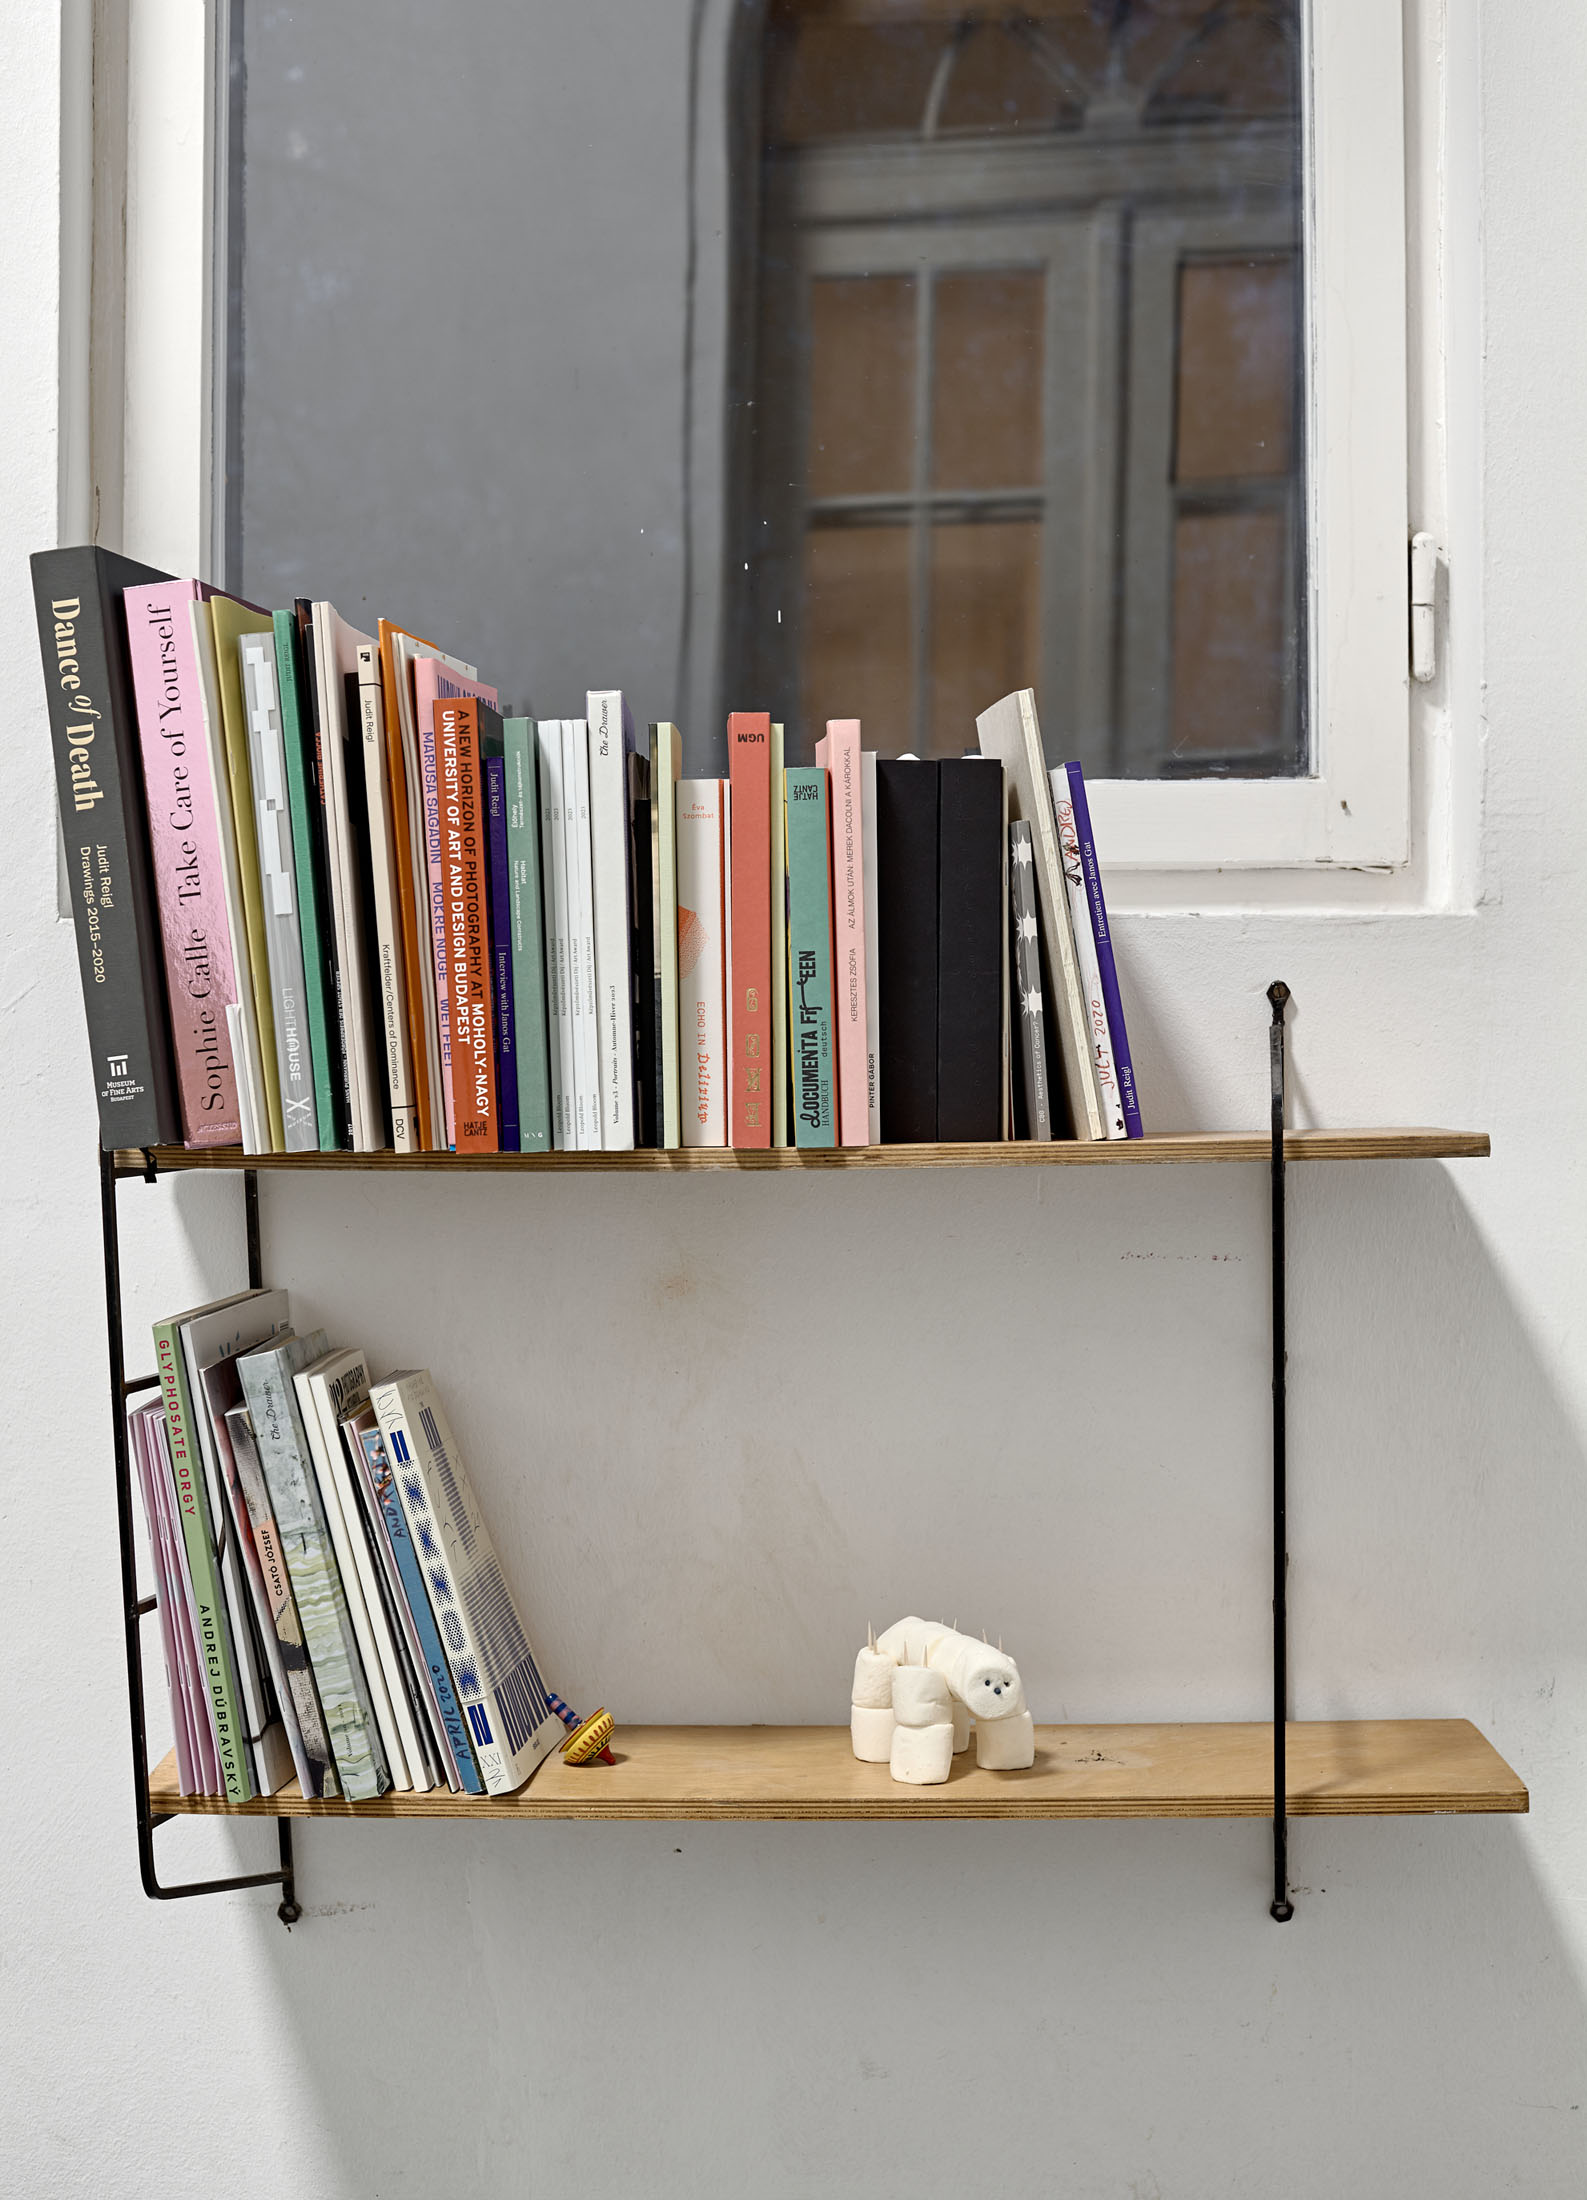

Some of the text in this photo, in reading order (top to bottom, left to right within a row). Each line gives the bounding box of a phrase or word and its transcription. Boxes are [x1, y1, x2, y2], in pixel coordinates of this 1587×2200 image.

[147, 603, 182, 722] Yourself
[283, 664, 292, 681] JUDIT
[52, 597, 103, 812] Dance of Death
[599, 698, 609, 738] Drawer
[160, 728, 186, 756] of
[599, 740, 609, 756] The
[737, 732, 765, 743] UGM
[793, 784, 818, 792] CANTZ
[843, 747, 852, 789] KÁROKKAL
[169, 766, 194, 830] Care
[793, 792, 819, 800] HATJE
[844, 799, 853, 833] DACOLNI
[845, 836, 854, 862] MEREK
[79, 846, 96, 905] Drawings
[95, 845, 114, 908] Judit Reigl
[173, 841, 203, 906] Take
[440, 710, 471, 1044] UNIVERSITY OF ART AND DESIGN BUDAPEST
[846, 864, 855, 887] UTÁN:
[364, 700, 405, 1139] Judit Reigl Kraftfelder/Centers of Dominance DCV
[431, 882, 445, 933] MOKRE
[458, 710, 490, 1116] A NEW HORIZON OF PHOTOGRAPHY AT MOHOLY-NAGY
[490, 772, 511, 1052] Judit Reigl Interview with Janos Gat
[846, 889, 855, 916] ÁLMOK
[848, 919, 856, 929] AZ
[185, 928, 211, 998] Calle
[848, 948, 857, 976] ZSÓFIA
[1083, 841, 1136, 1109] Judit Reigl Entretien avec Janos Gat
[849, 978, 858, 1022] KERESZTES
[1091, 999, 1106, 1036] 2020
[610, 1003, 618, 1051] Automne-Hiver
[193, 1010, 228, 1110] Sophie
[611, 1057, 620, 1085] Portraits
[697, 1002, 711, 1125] ECHO IN Delirium
[820, 1021, 829, 1126] HANDBUCH deutsch
[1036, 1061, 1044, 1099] Aesthetics
[107, 1080, 135, 1088] MUSEUM
[126, 1086, 144, 1094] ARTS
[463, 1121, 488, 1130] HATJE
[612, 1099, 620, 1124] Volume
[262, 1379, 277, 1421] Drawer
[270, 1423, 281, 1440] The
[158, 1340, 241, 1796] GLYPHOSATE ORGY ANDREJ DÚBRAVSKÝ
[261, 1529, 283, 1596] CSATÓ JÓZSEF
[432, 1665, 452, 1702] 2020
[444, 1706, 470, 1759] APRIL
